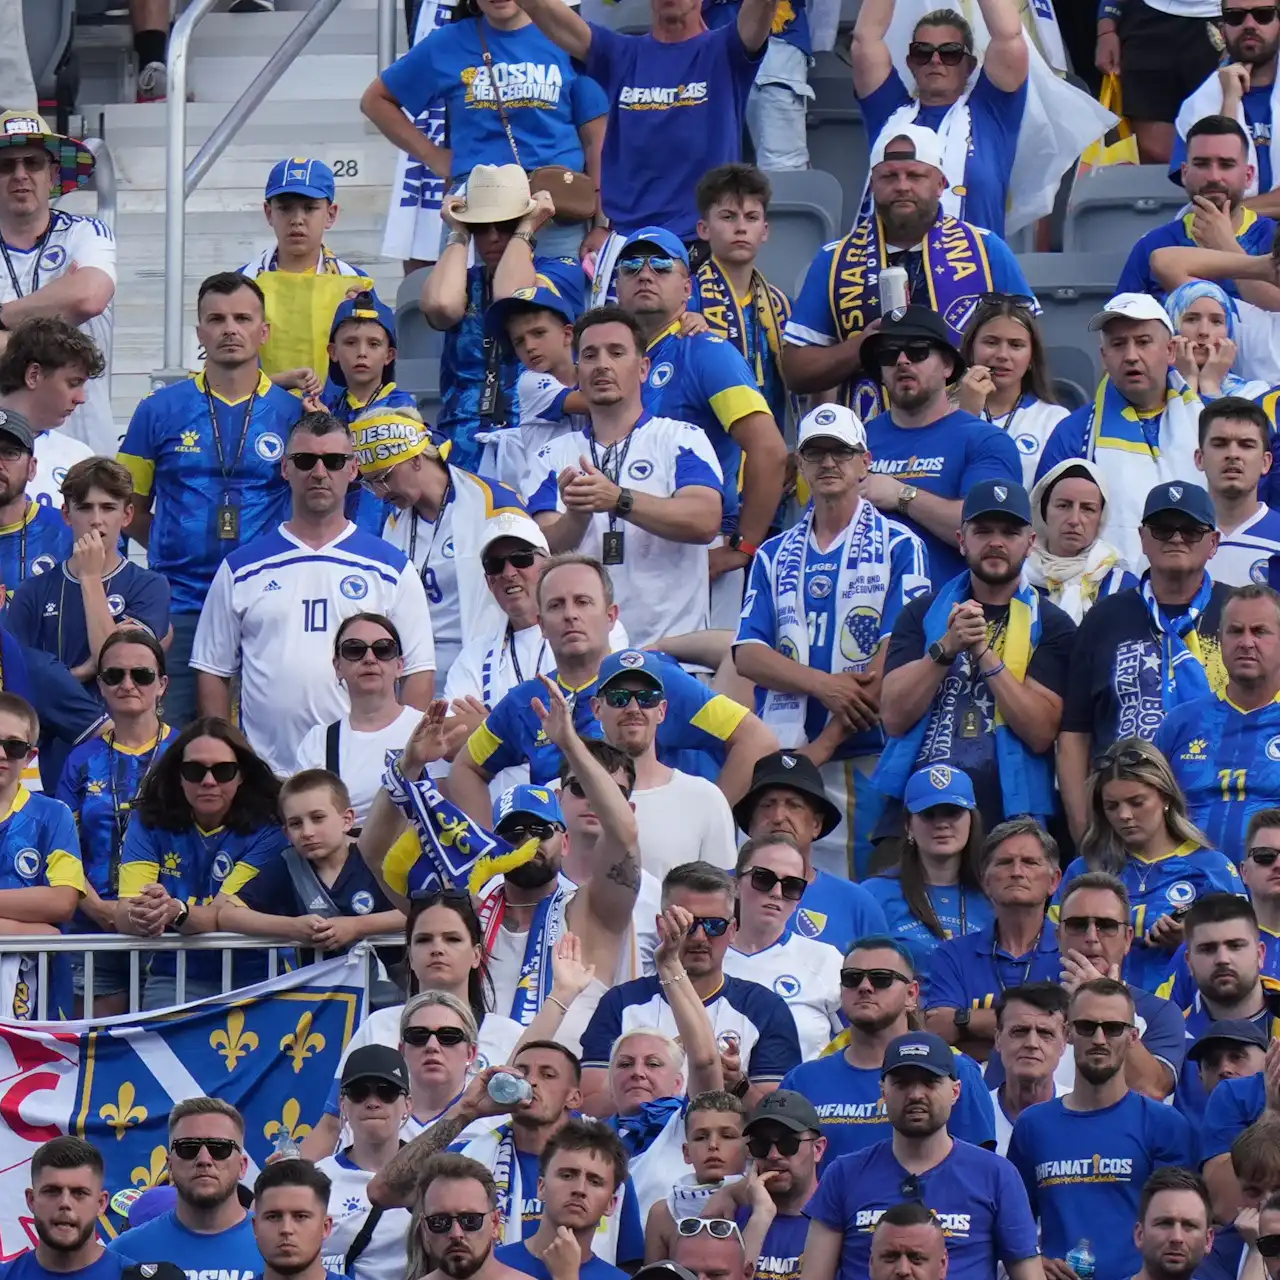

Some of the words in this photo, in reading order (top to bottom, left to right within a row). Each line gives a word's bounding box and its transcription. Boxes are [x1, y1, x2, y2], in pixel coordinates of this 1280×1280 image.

[473, 62, 563, 89] BOSNA
[333, 160, 358, 178] 28
[302, 599, 327, 632] 10
[1180, 752, 1208, 761] KELME
[1218, 770, 1247, 802] 11
